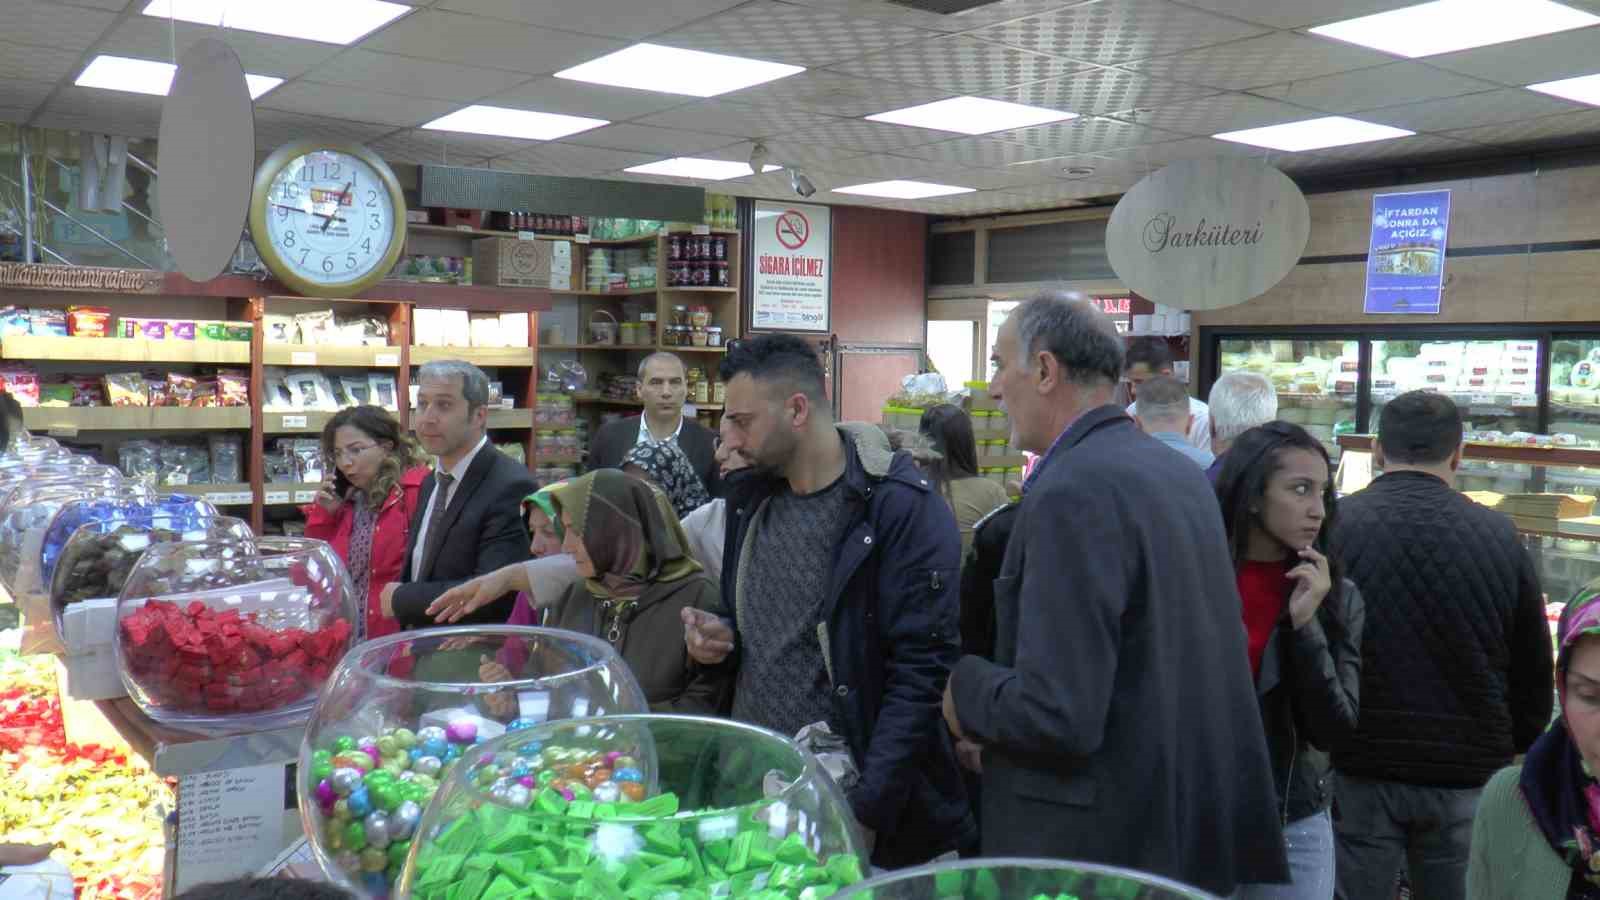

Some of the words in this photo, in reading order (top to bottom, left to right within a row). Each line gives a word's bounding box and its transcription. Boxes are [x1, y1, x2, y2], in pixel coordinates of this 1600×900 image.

[302, 166, 314, 182] 11
[322, 162, 341, 180] 12
[352, 171, 357, 187] 1
[282, 182, 299, 199] 10
[366, 190, 377, 208] 2
[277, 205, 288, 223] 9
[1384, 207, 1439, 218] İFTARDAN
[1422, 217, 1438, 226] DA
[369, 213, 381, 231] 3
[283, 230, 296, 248] 8
[1142, 212, 1264, 253] Sarküteri
[361, 237, 371, 254] 4
[299, 248, 311, 265] 7
[322, 255, 334, 273] 6
[345, 252, 357, 270] 5
[759, 253, 790, 276] SİGARA
[791, 255, 824, 279] İÇİLMEZ
